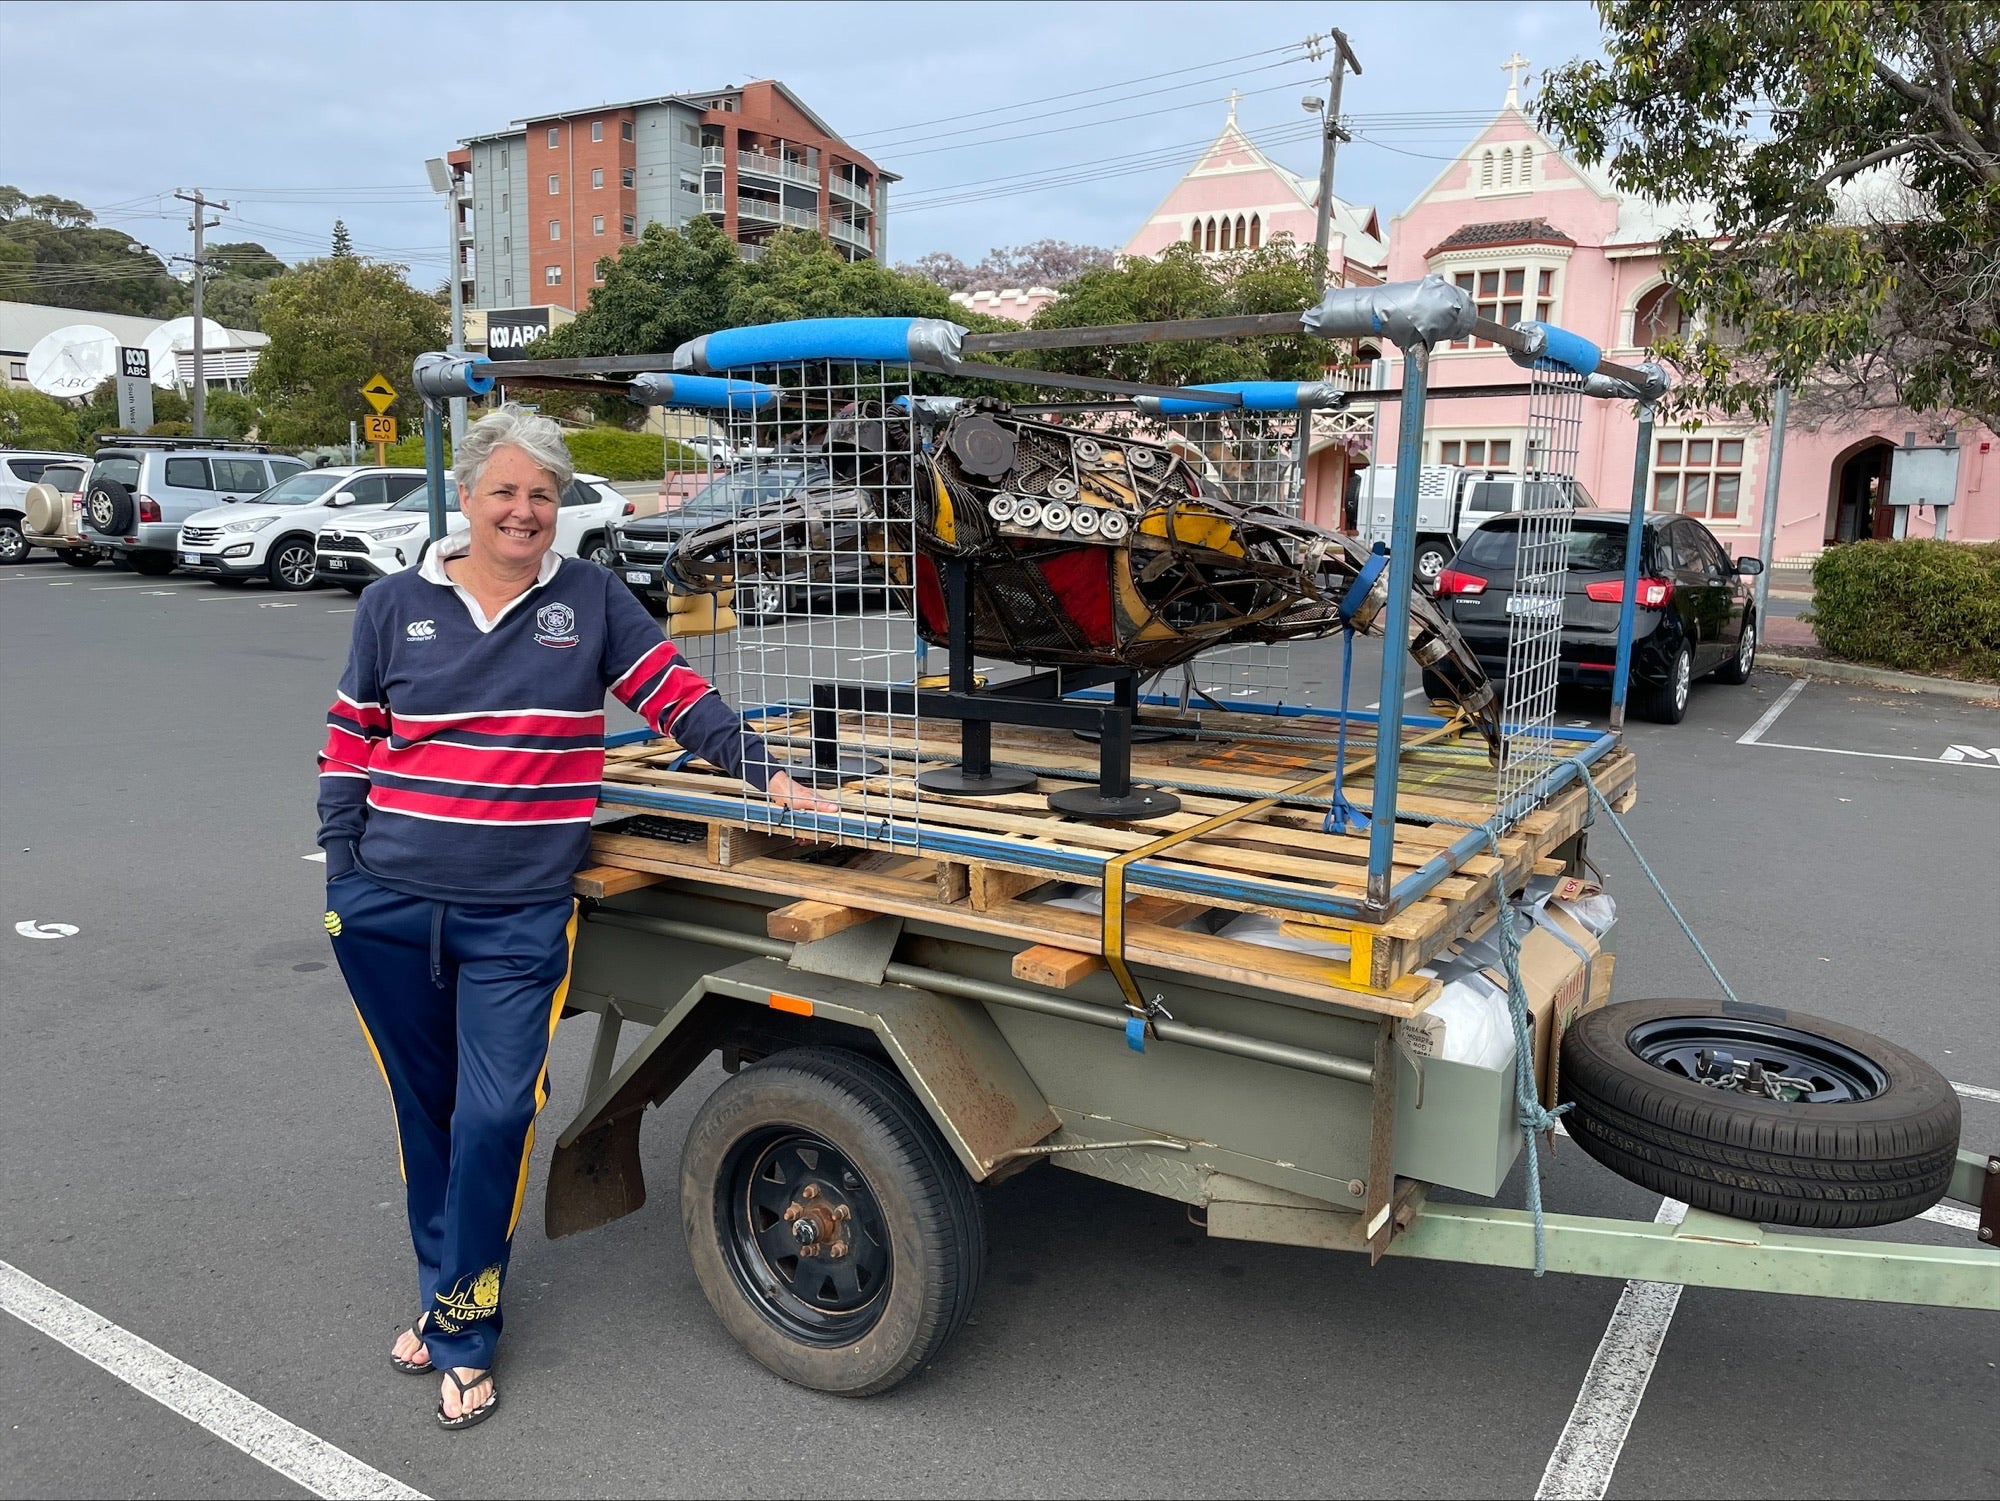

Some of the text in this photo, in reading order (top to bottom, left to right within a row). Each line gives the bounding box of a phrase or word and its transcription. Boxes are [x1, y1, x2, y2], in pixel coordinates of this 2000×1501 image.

[510, 325, 547, 347] ABC
[126, 366, 147, 377] ABC
[52, 377, 97, 388] ABC
[127, 382, 135, 404] South
[372, 418, 391, 432] 20
[406, 634, 437, 642] canterbury
[446, 1307, 497, 1321] AUSTRA
